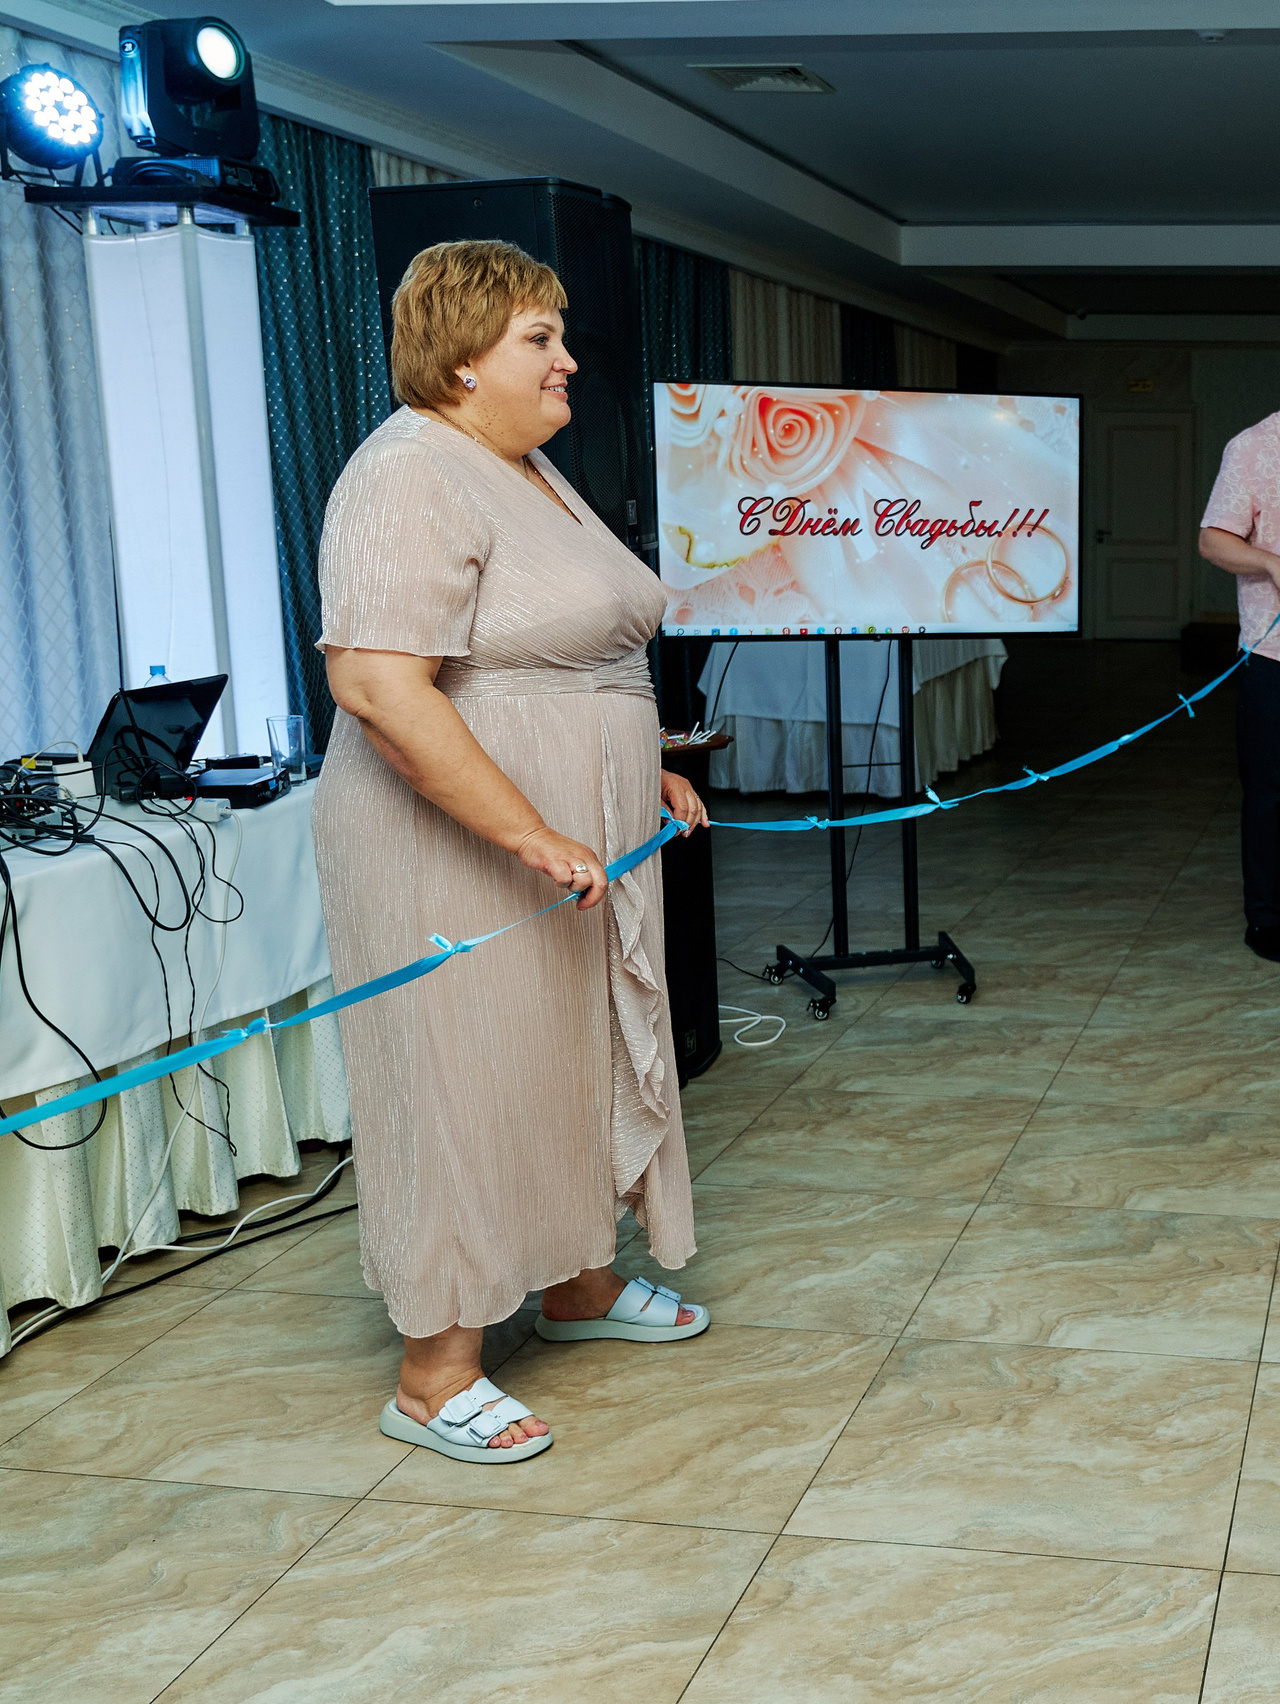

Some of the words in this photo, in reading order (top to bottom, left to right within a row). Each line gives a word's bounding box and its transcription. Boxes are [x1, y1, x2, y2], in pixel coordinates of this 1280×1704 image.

[738, 496, 774, 536] С
[768, 496, 863, 537] Днём
[873, 498, 1050, 550] Свадьбы!!!
